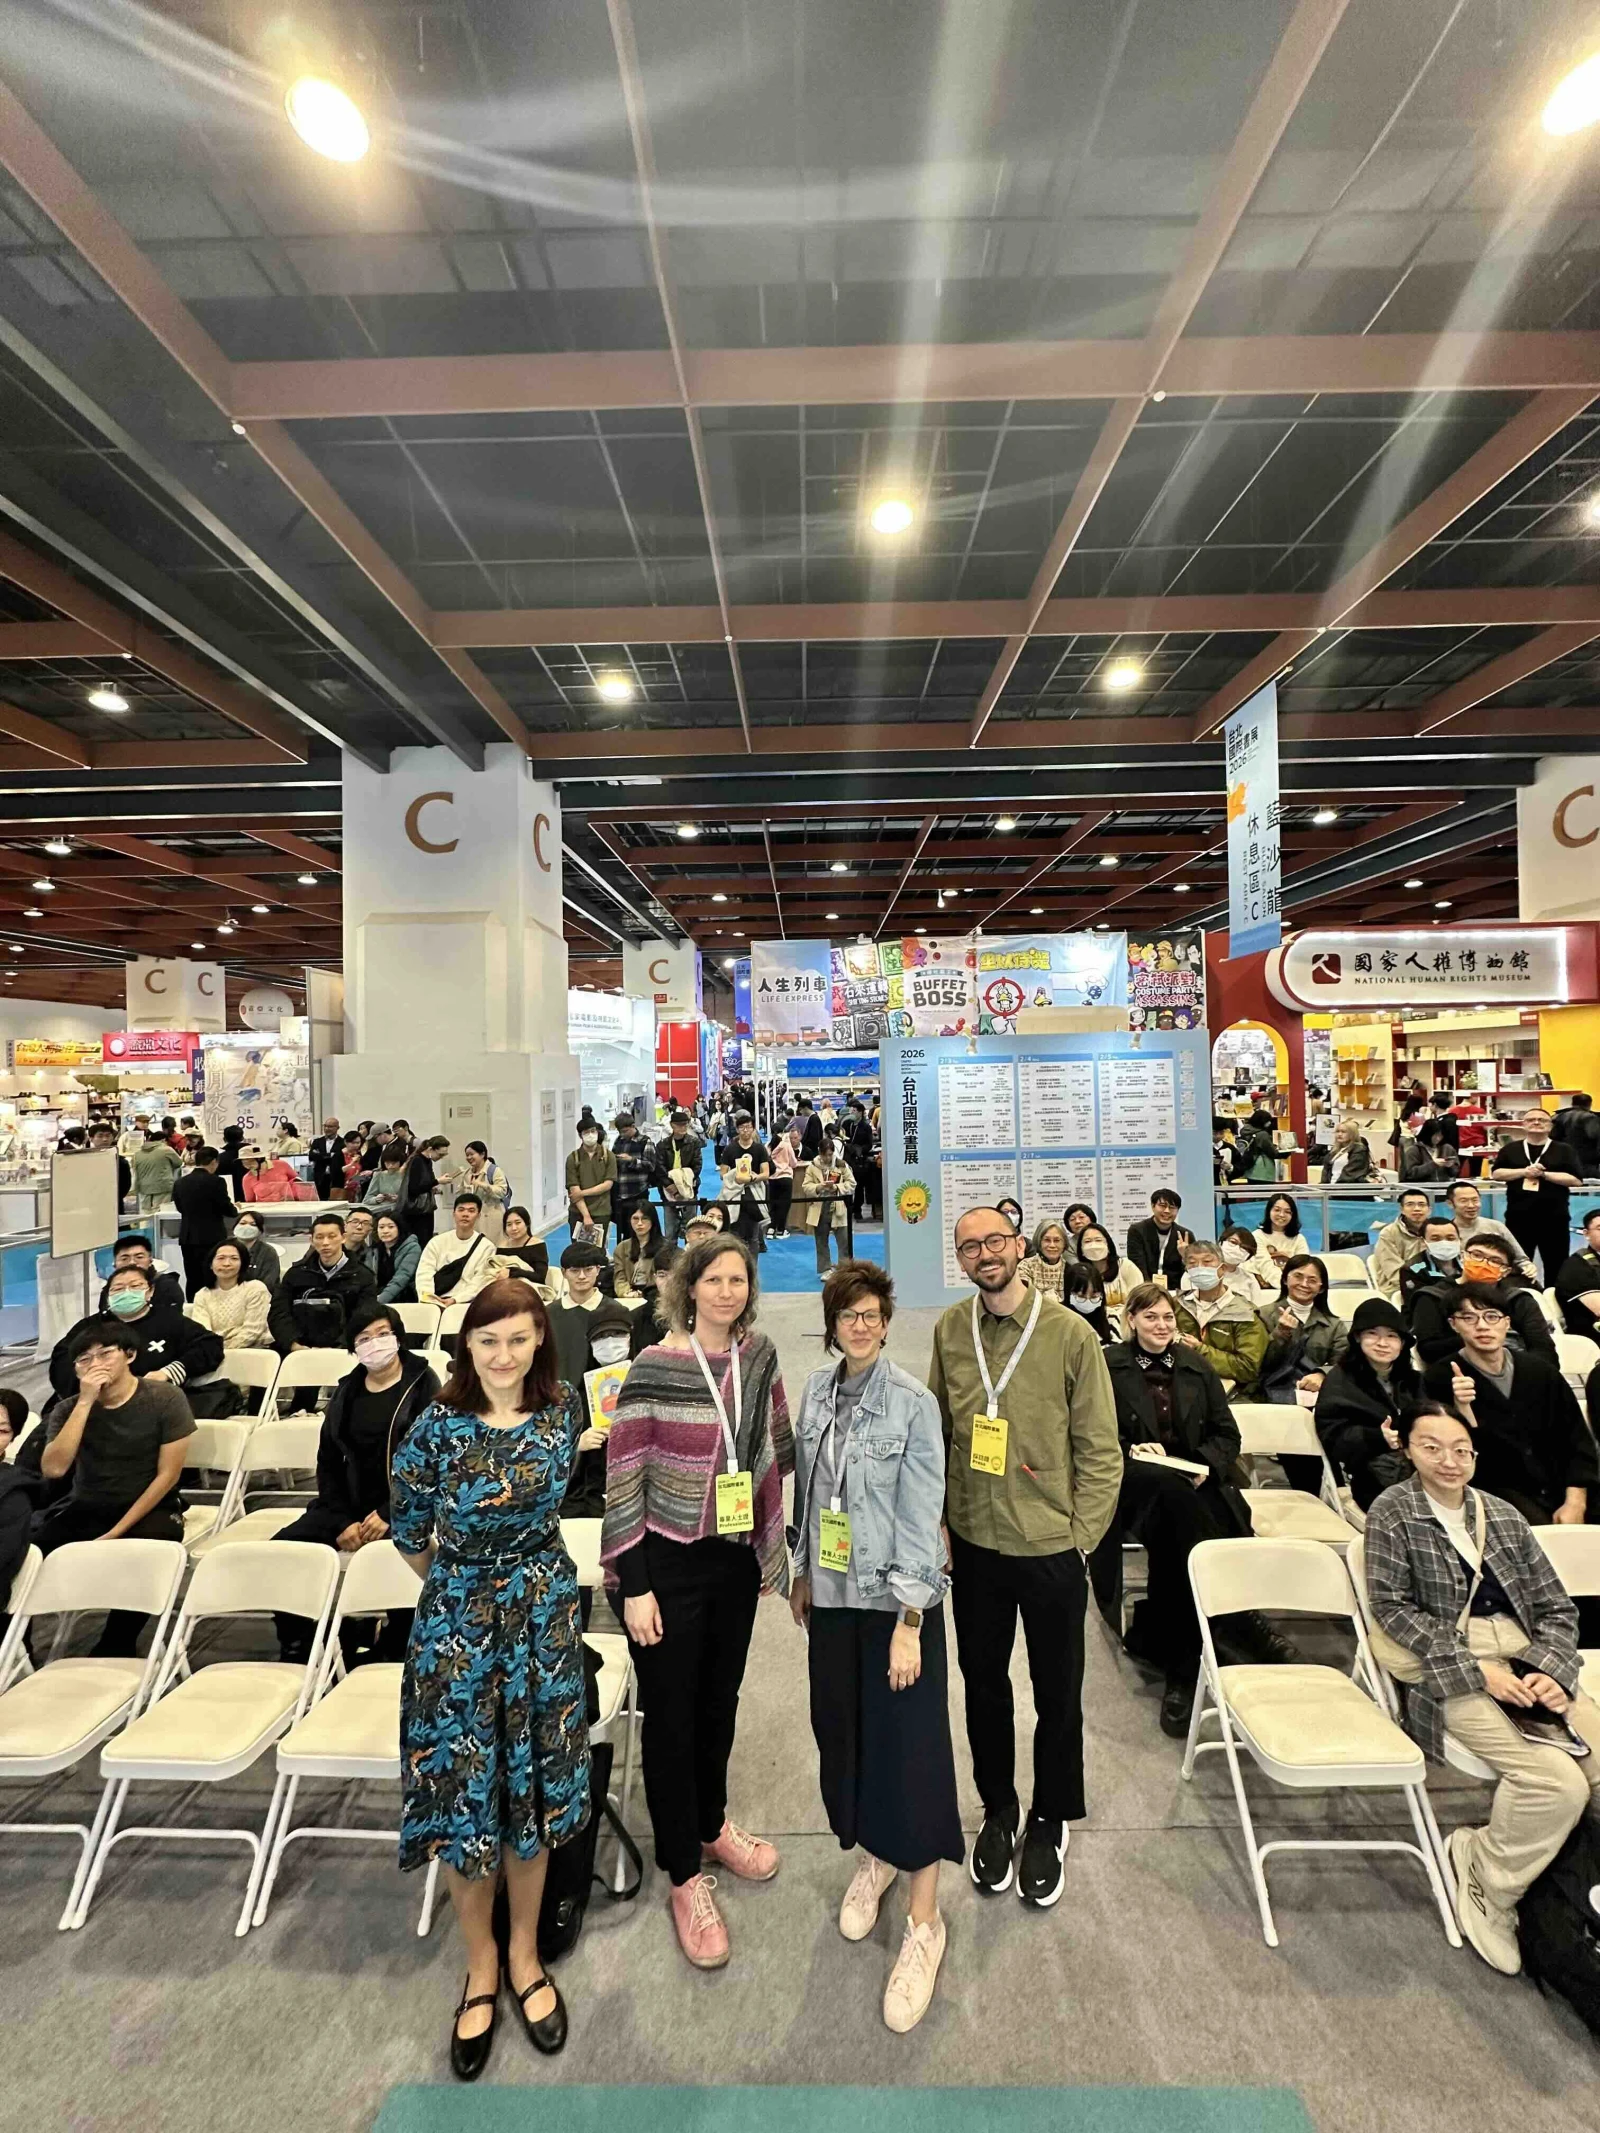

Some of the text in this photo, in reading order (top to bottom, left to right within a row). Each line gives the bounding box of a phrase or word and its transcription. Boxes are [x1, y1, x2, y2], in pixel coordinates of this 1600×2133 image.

[1229, 722, 1243, 745] 台北
[1229, 726, 1258, 761] 國際書展
[1229, 753, 1247, 774] 2026
[405, 791, 460, 853] C
[1553, 784, 1600, 848] C
[533, 813, 551, 872] C
[1267, 799, 1282, 914] 藍沙龍
[648, 959, 671, 984] C
[1354, 950, 1531, 974] 國家人權博物館
[144, 969, 167, 994] C
[197, 972, 214, 996] C
[758, 976, 828, 993] 人生列車
[913, 979, 967, 991] BUFFET
[1135, 986, 1196, 996] COSTUME PARTY
[1355, 977, 1406, 985] NATIONAL
[1490, 974, 1531, 982] MUSEUM
[761, 994, 824, 1003] LIFE EXPRESS
[913, 991, 967, 1007] BOSS
[1135, 994, 1197, 1007] ASSASSINS
[900, 1049, 925, 1058] 2026
[237, 1116, 255, 1130] 85
[902, 1076, 919, 1165] 台北國際書展
